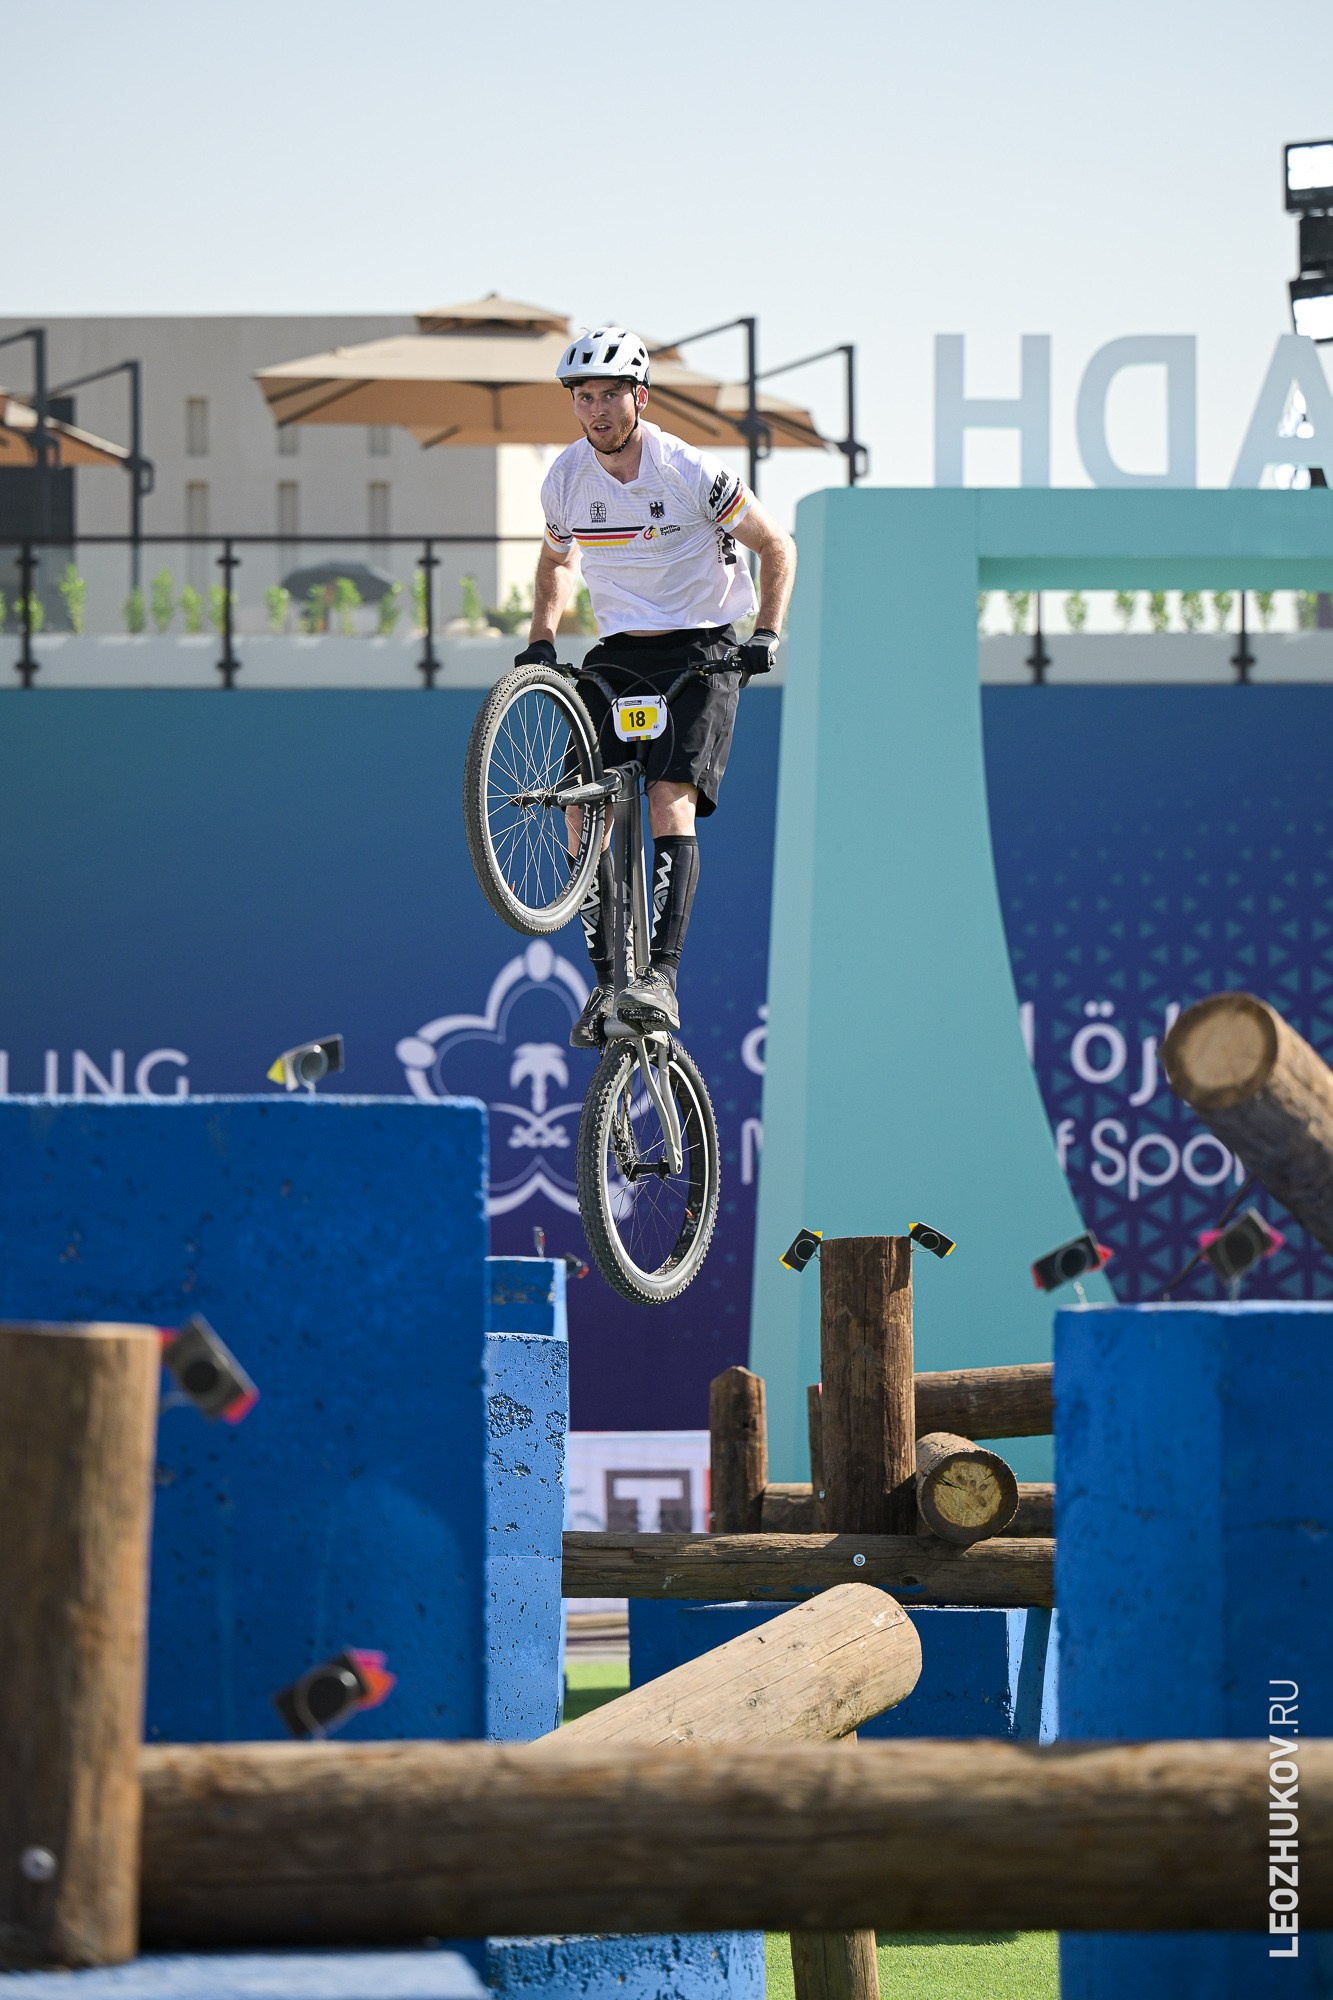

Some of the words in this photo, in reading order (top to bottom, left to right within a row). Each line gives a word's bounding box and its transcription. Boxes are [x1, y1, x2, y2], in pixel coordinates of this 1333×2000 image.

[708, 471, 729, 508] KTM
[628, 710, 646, 728] 18
[1090, 1118, 1246, 1201] Spo
